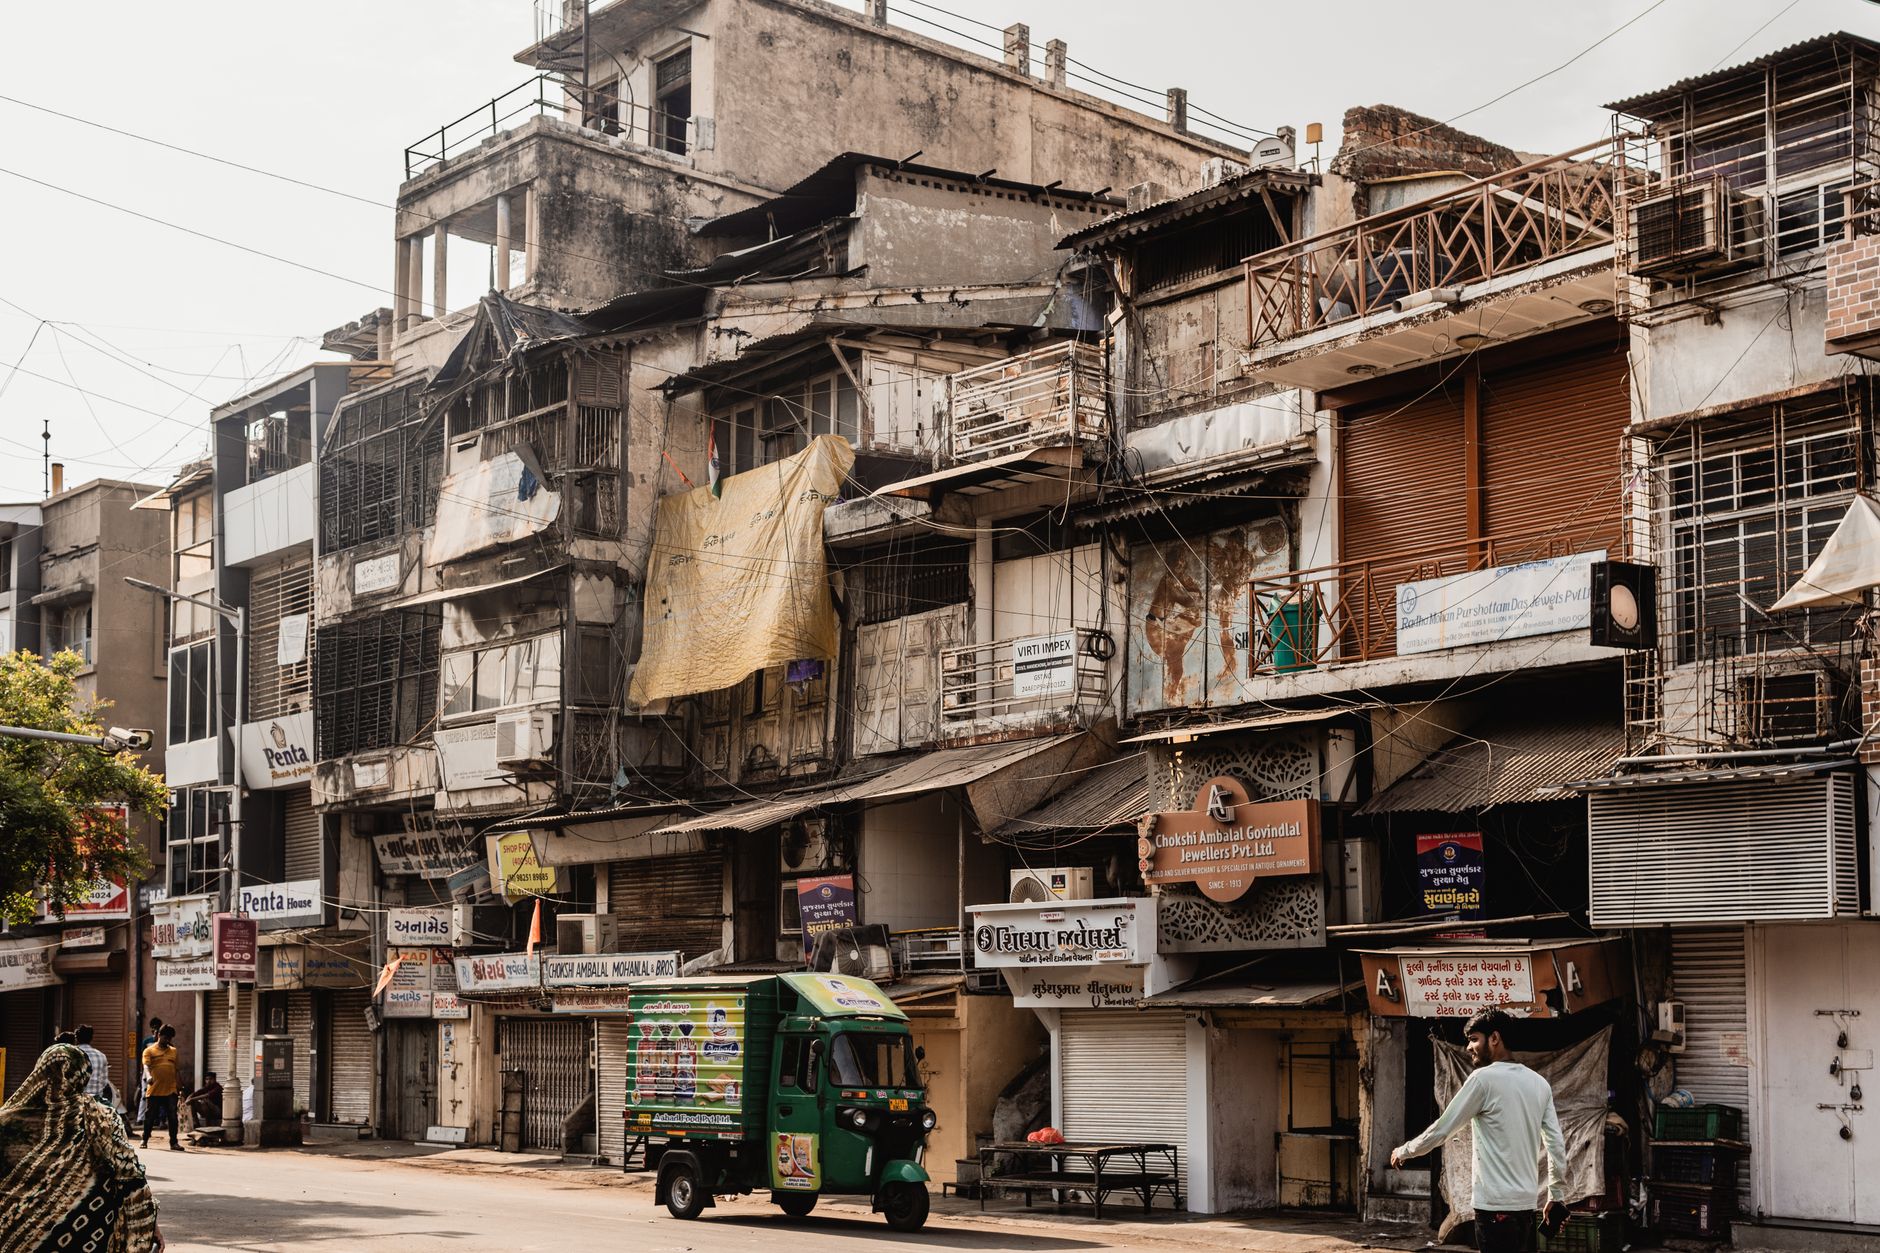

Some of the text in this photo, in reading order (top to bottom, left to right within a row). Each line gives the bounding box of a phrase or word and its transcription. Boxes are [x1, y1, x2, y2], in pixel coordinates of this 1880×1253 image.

[1017, 639, 1071, 657] VIRTI IMPEX
[263, 744, 310, 769] Penta
[1155, 821, 1301, 849] Chokshi Ambalal Govindlal
[503, 844, 517, 854] SHOP
[1180, 841, 1276, 864] Jewellers Pvt. Ltd.
[1174, 868, 1191, 876] SILVER
[1190, 866, 1216, 875] MERCHANT
[1217, 865, 1221, 873] &
[1221, 863, 1248, 873] SPECIALIST
[1249, 863, 1255, 871] IN
[1255, 861, 1276, 871] ANTIQUE
[1276, 858, 1306, 868] ORNAMENTS
[1420, 864, 1482, 878] ગુજરાત સુવર્ણકાર
[1208, 881, 1225, 890] SINCE
[1229, 880, 1243, 889] 1913
[1433, 875, 1469, 886] સુરક્ષા સેતુ
[242, 890, 312, 912] Penta House
[394, 915, 449, 934] અનામેડ
[548, 962, 574, 980] CHOKSHI
[576, 960, 609, 978] AMBALAL
[612, 960, 651, 977] MOHANLAL
[655, 959, 675, 976] BROS
[1457, 963, 1477, 975] દુકાન
[1481, 960, 1511, 971] વેચવાની
[1436, 1003, 1455, 1015] ટોટલ
[680, 1114, 700, 1123] Food
